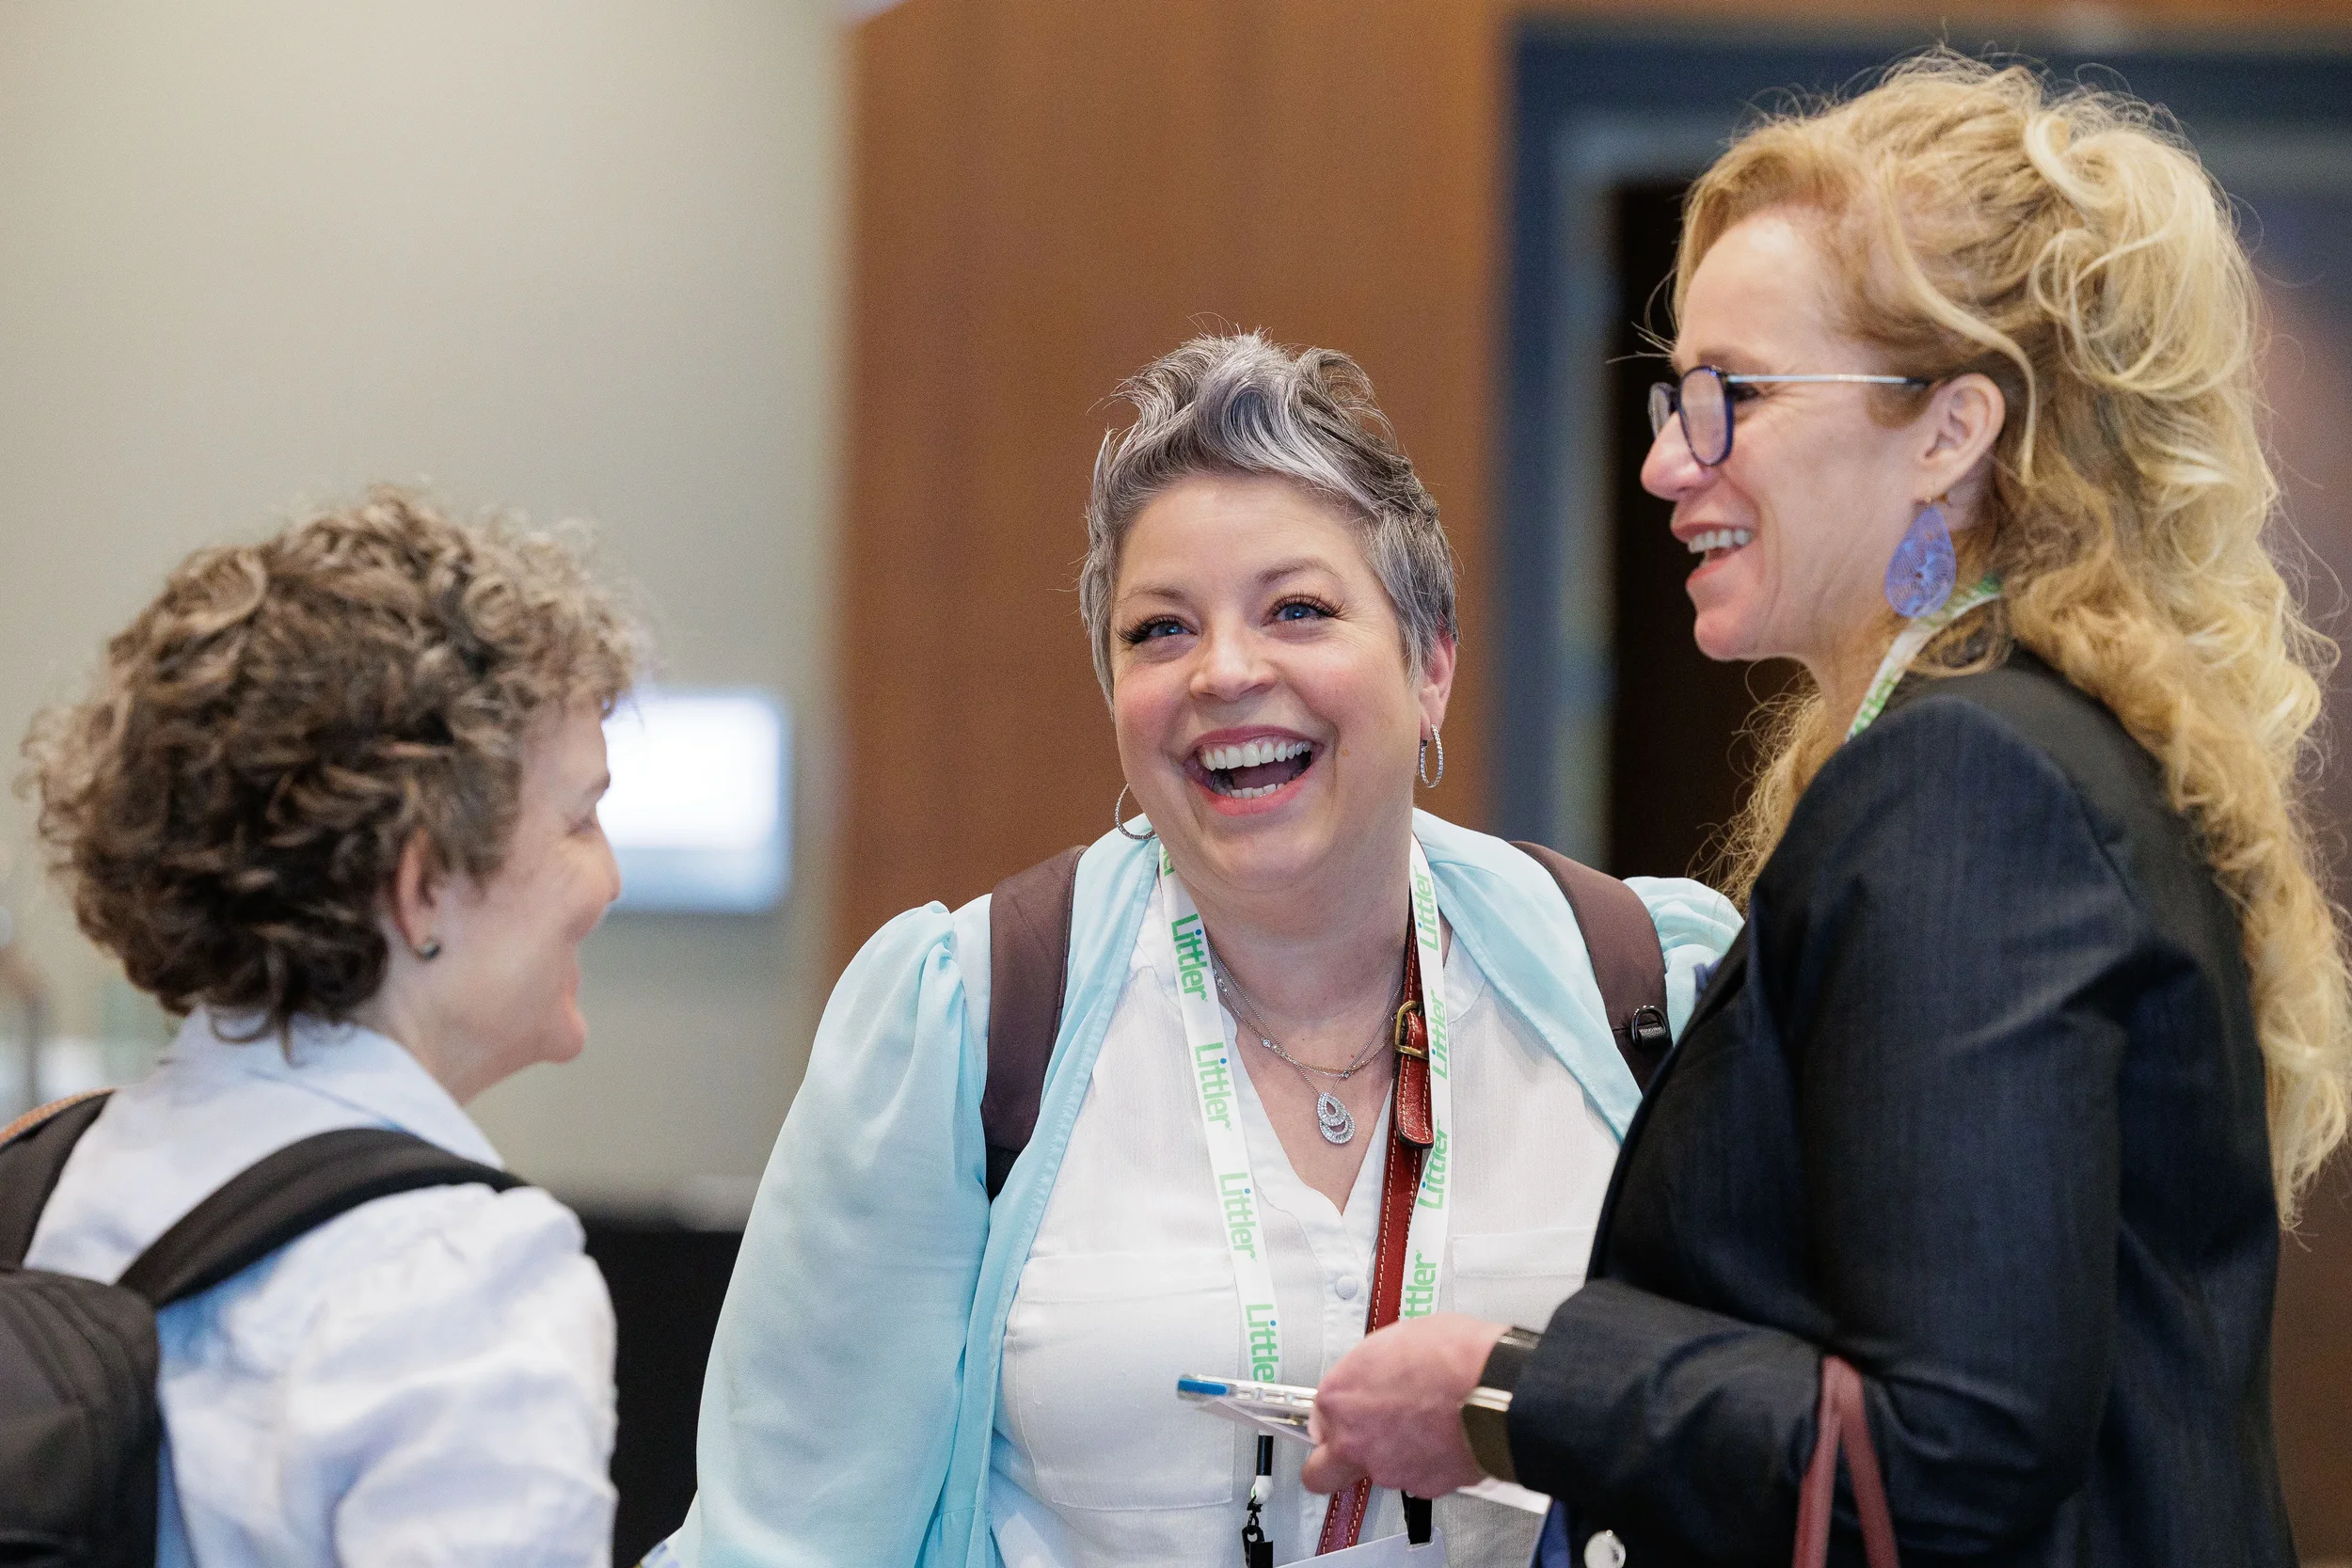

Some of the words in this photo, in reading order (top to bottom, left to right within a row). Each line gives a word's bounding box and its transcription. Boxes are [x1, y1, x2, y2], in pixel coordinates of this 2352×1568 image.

[1412, 865, 1438, 950] Littler
[1171, 913, 1207, 1001] Littler
[1430, 989, 1448, 1080] Littler
[1195, 1042, 1231, 1129] Littler
[1418, 1119, 1448, 1210] Littler
[1219, 1173, 1255, 1259] Littler
[1404, 1250, 1437, 1320] ttler
[1245, 1304, 1279, 1384] Little
